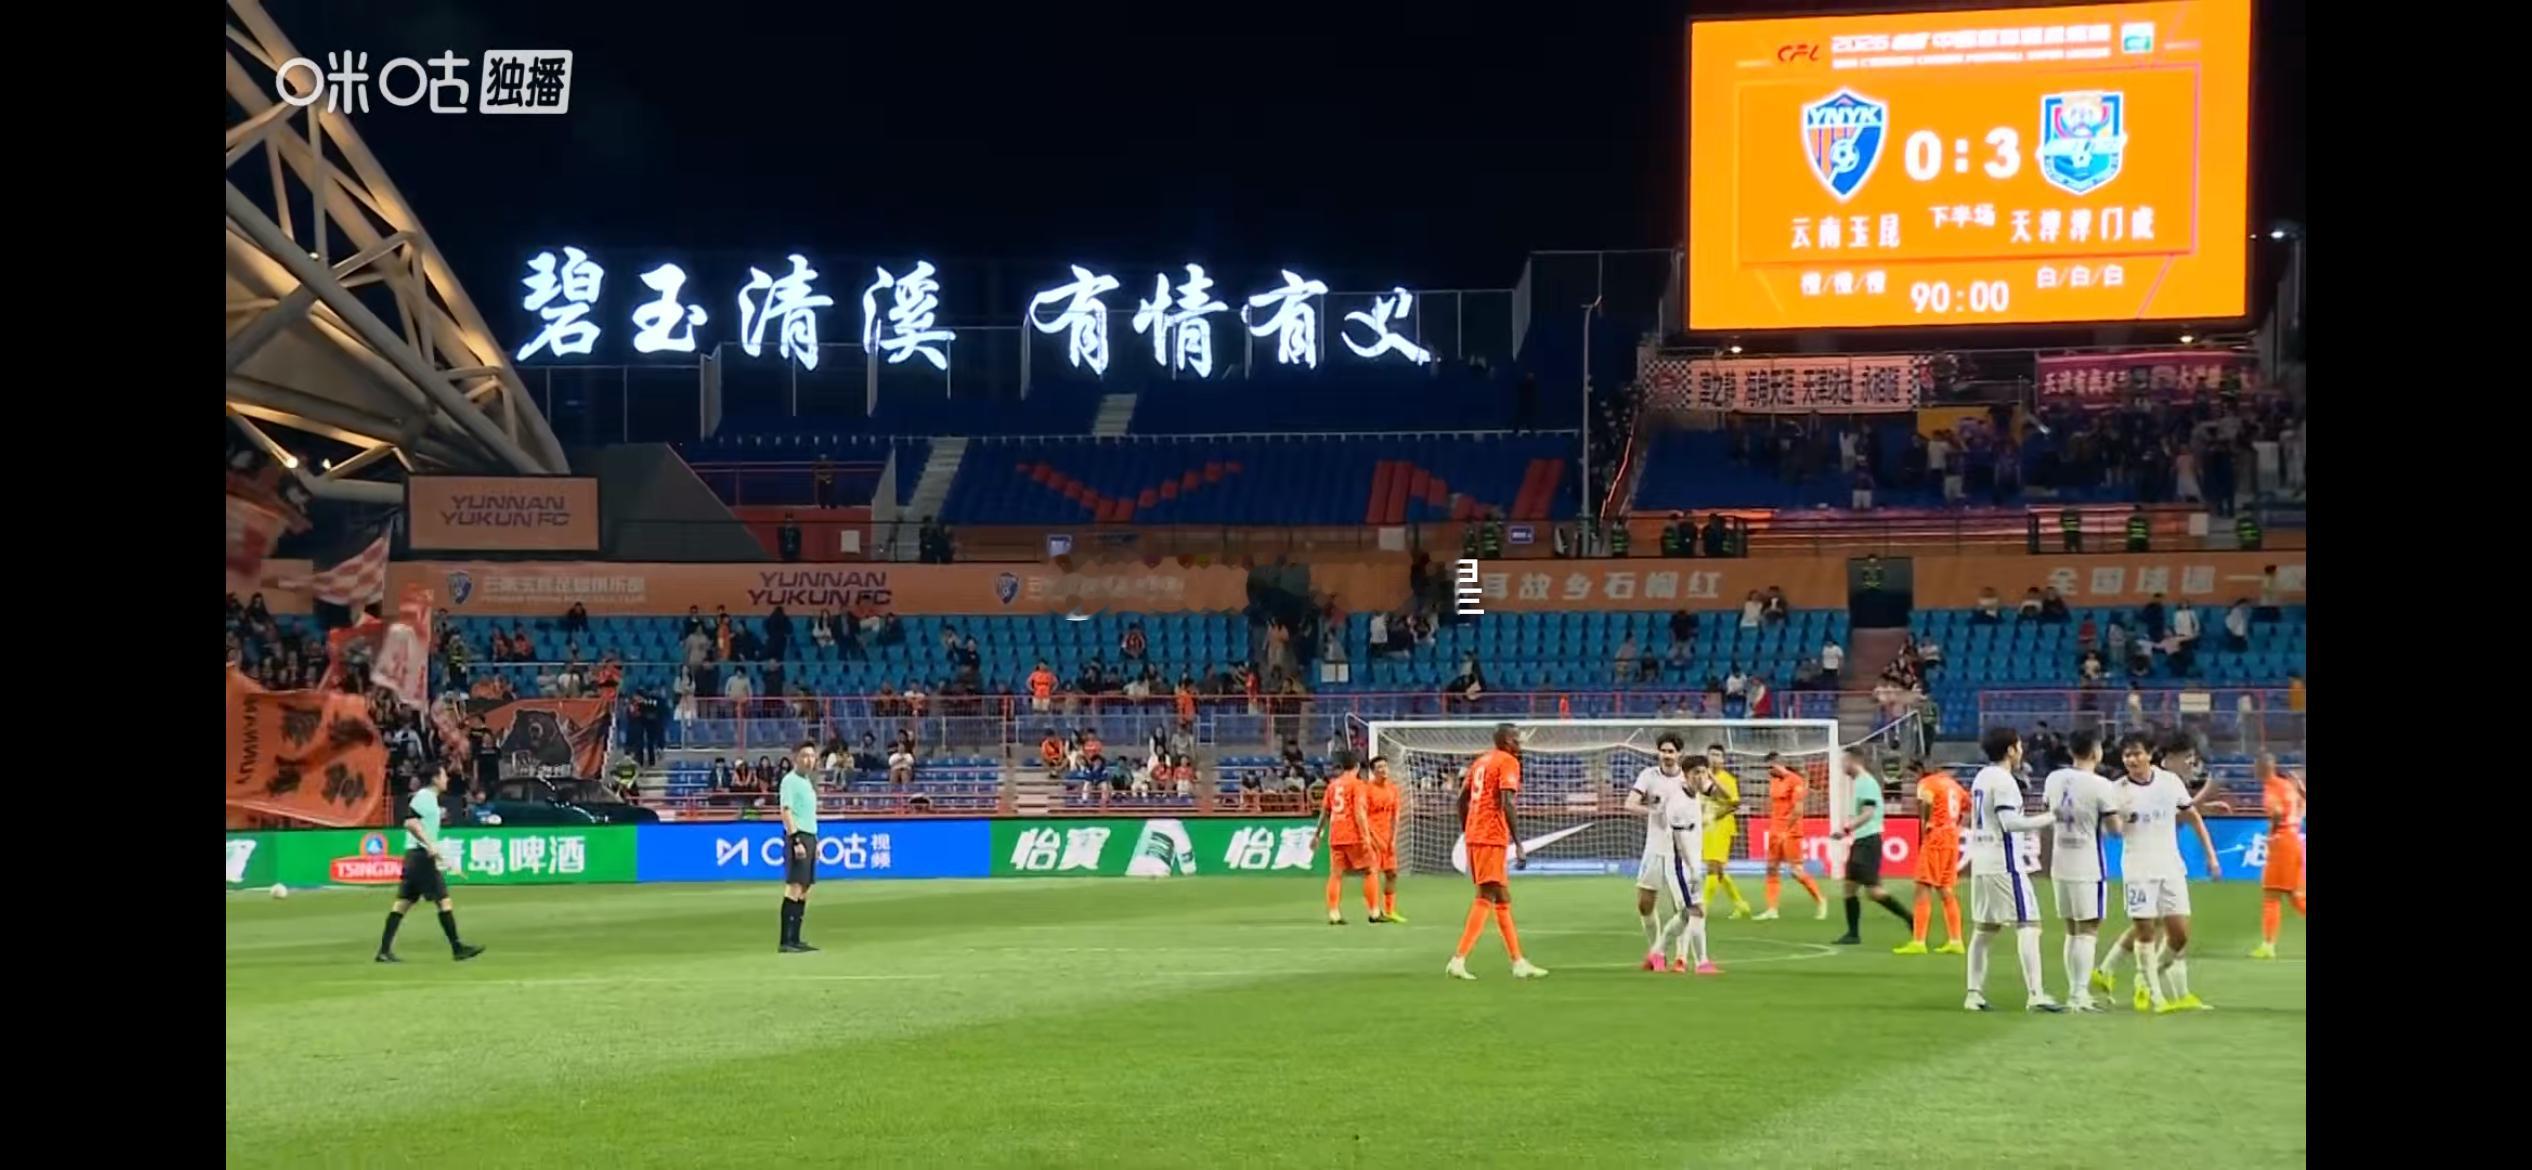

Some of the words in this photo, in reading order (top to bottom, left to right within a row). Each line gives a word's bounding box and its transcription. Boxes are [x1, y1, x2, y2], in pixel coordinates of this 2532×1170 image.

[1807, 106, 1881, 125] YNYK
[1930, 203, 1996, 228] 下半场
[1791, 213, 1900, 249] 云南玉昆
[1910, 281, 2009, 313] 90:00
[516, 247, 957, 370] 碧玉清溪
[1030, 263, 1432, 377] 有情有义
[451, 496, 564, 509] YUNNAN
[441, 511, 532, 526] YUKUN
[538, 512, 570, 526] FC
[760, 571, 887, 587] YUNNAN
[748, 589, 848, 605] YUKUN
[854, 590, 892, 605] FC
[1333, 785, 1345, 812] 5
[2128, 887, 2147, 906] 24
